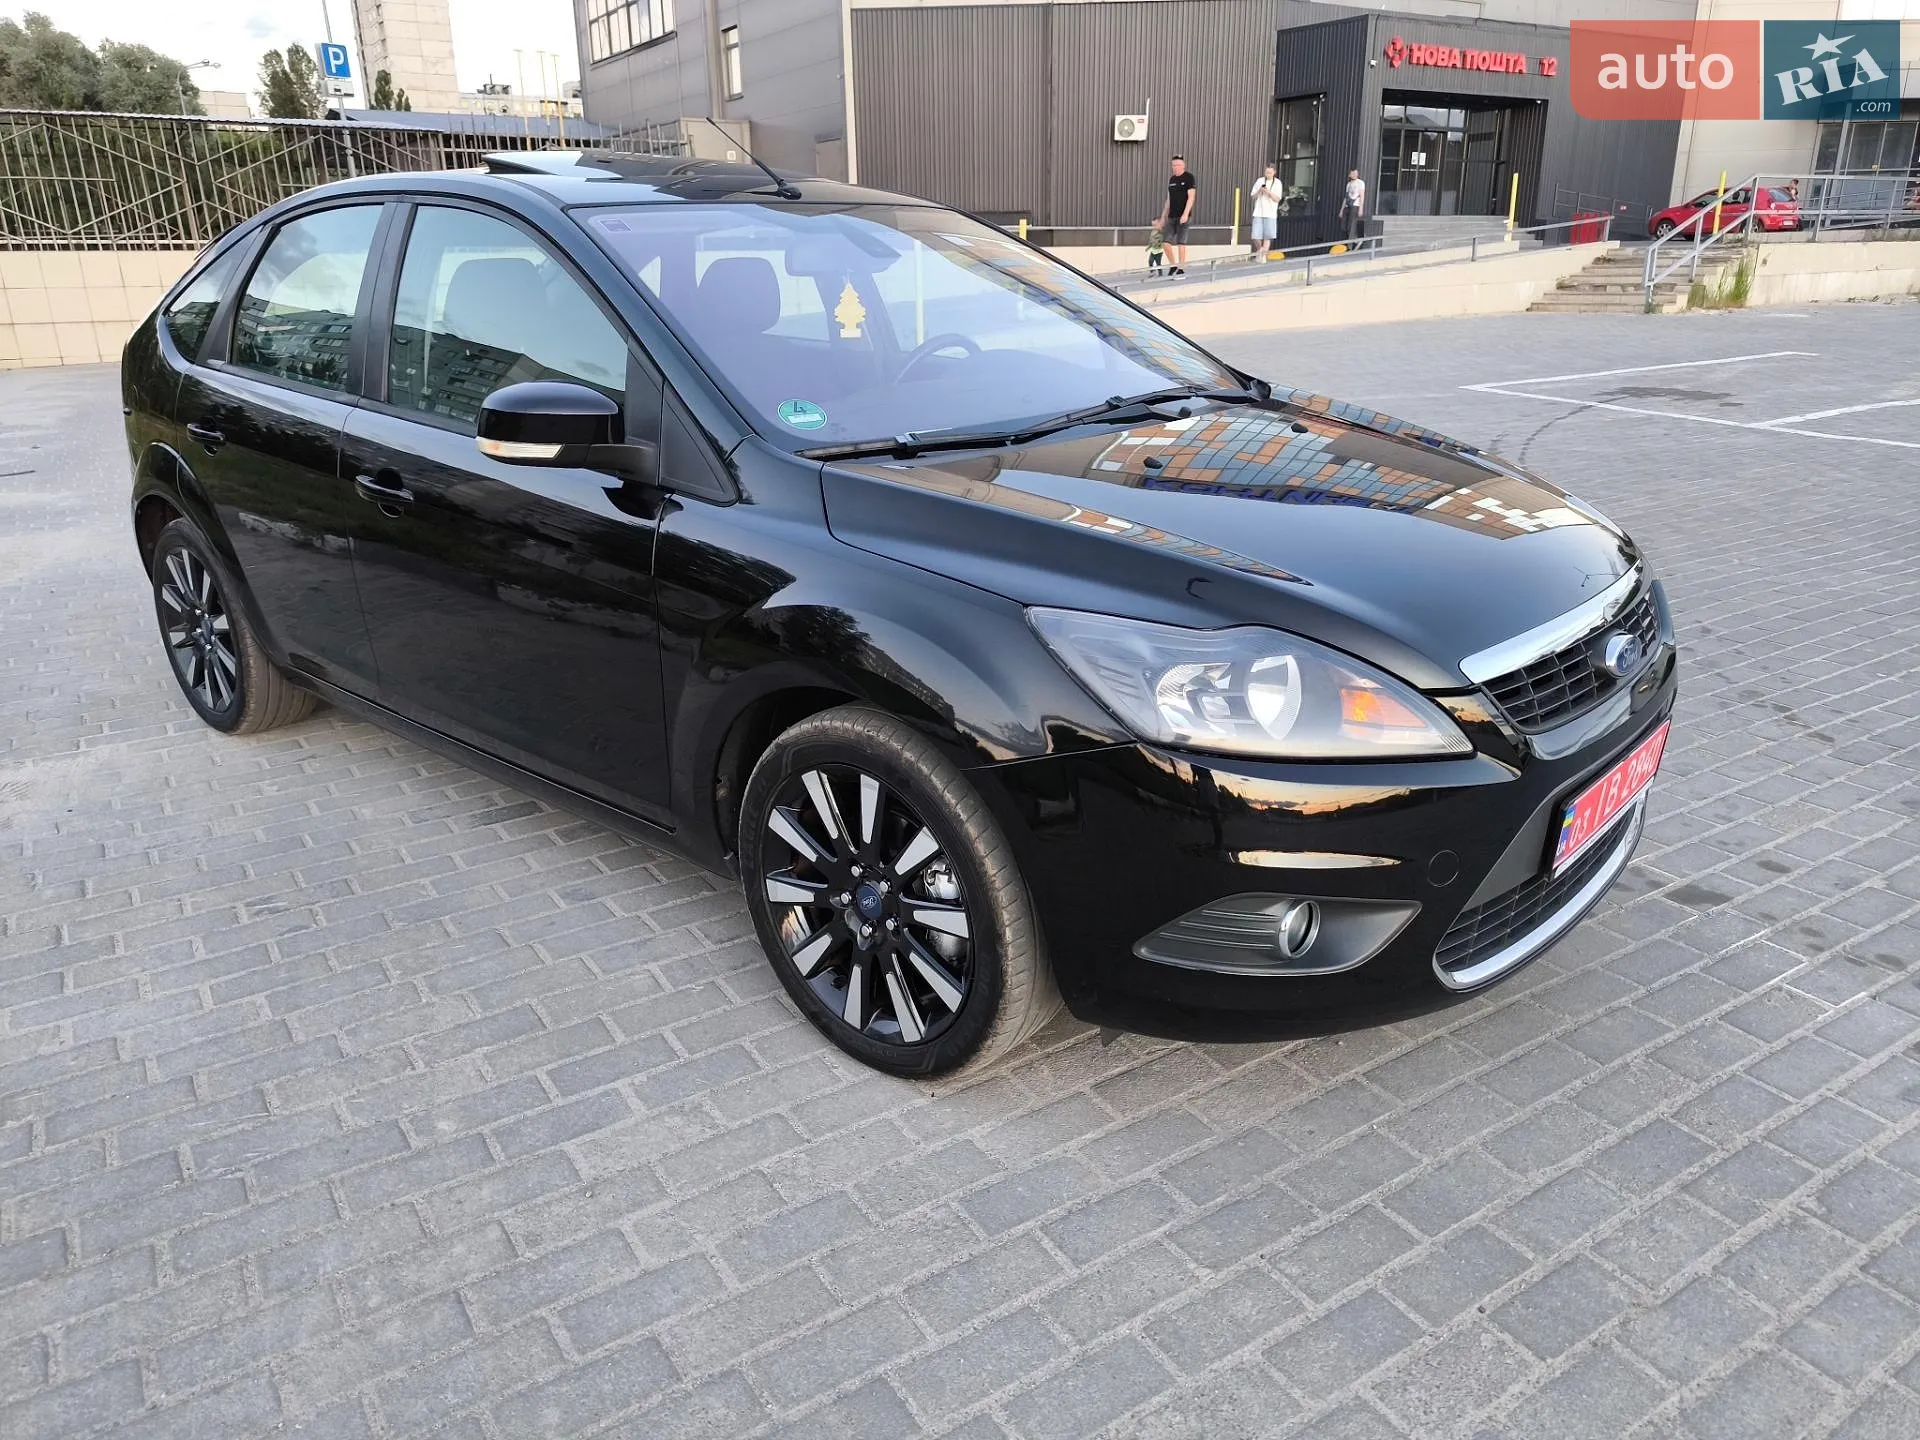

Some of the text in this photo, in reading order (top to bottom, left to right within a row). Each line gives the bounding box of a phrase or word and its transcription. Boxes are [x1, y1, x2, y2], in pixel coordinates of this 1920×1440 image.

[328, 47, 344, 74] P
[1410, 44, 1558, 76] НОВА ПОШТА 12
